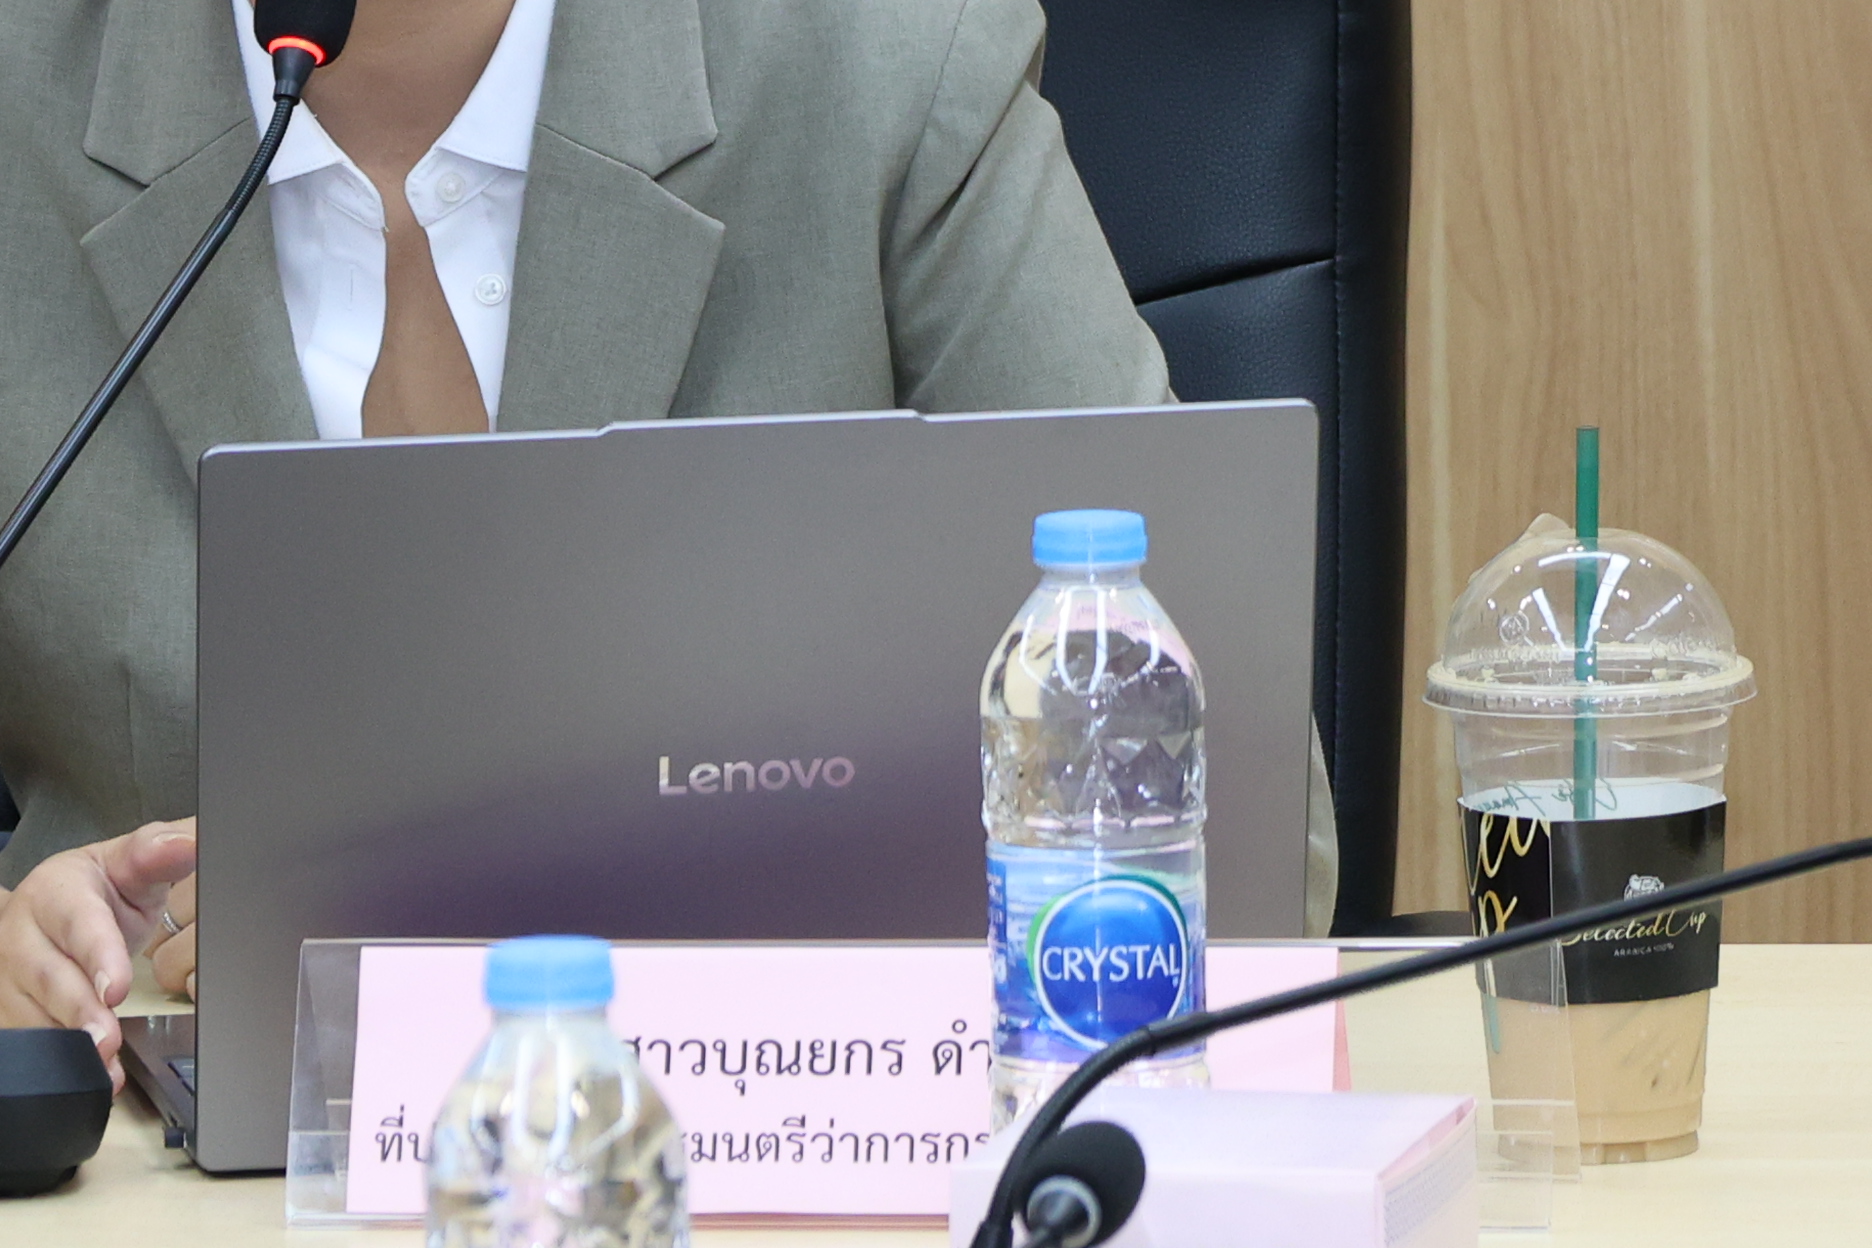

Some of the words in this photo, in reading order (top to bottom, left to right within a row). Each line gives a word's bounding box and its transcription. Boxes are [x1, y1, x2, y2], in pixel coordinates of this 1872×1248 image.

[658, 755, 856, 796] Lenovo
[1041, 943, 1180, 983] CRYSTAL
[681, 1114, 990, 1164] มนตรีว่าการก
